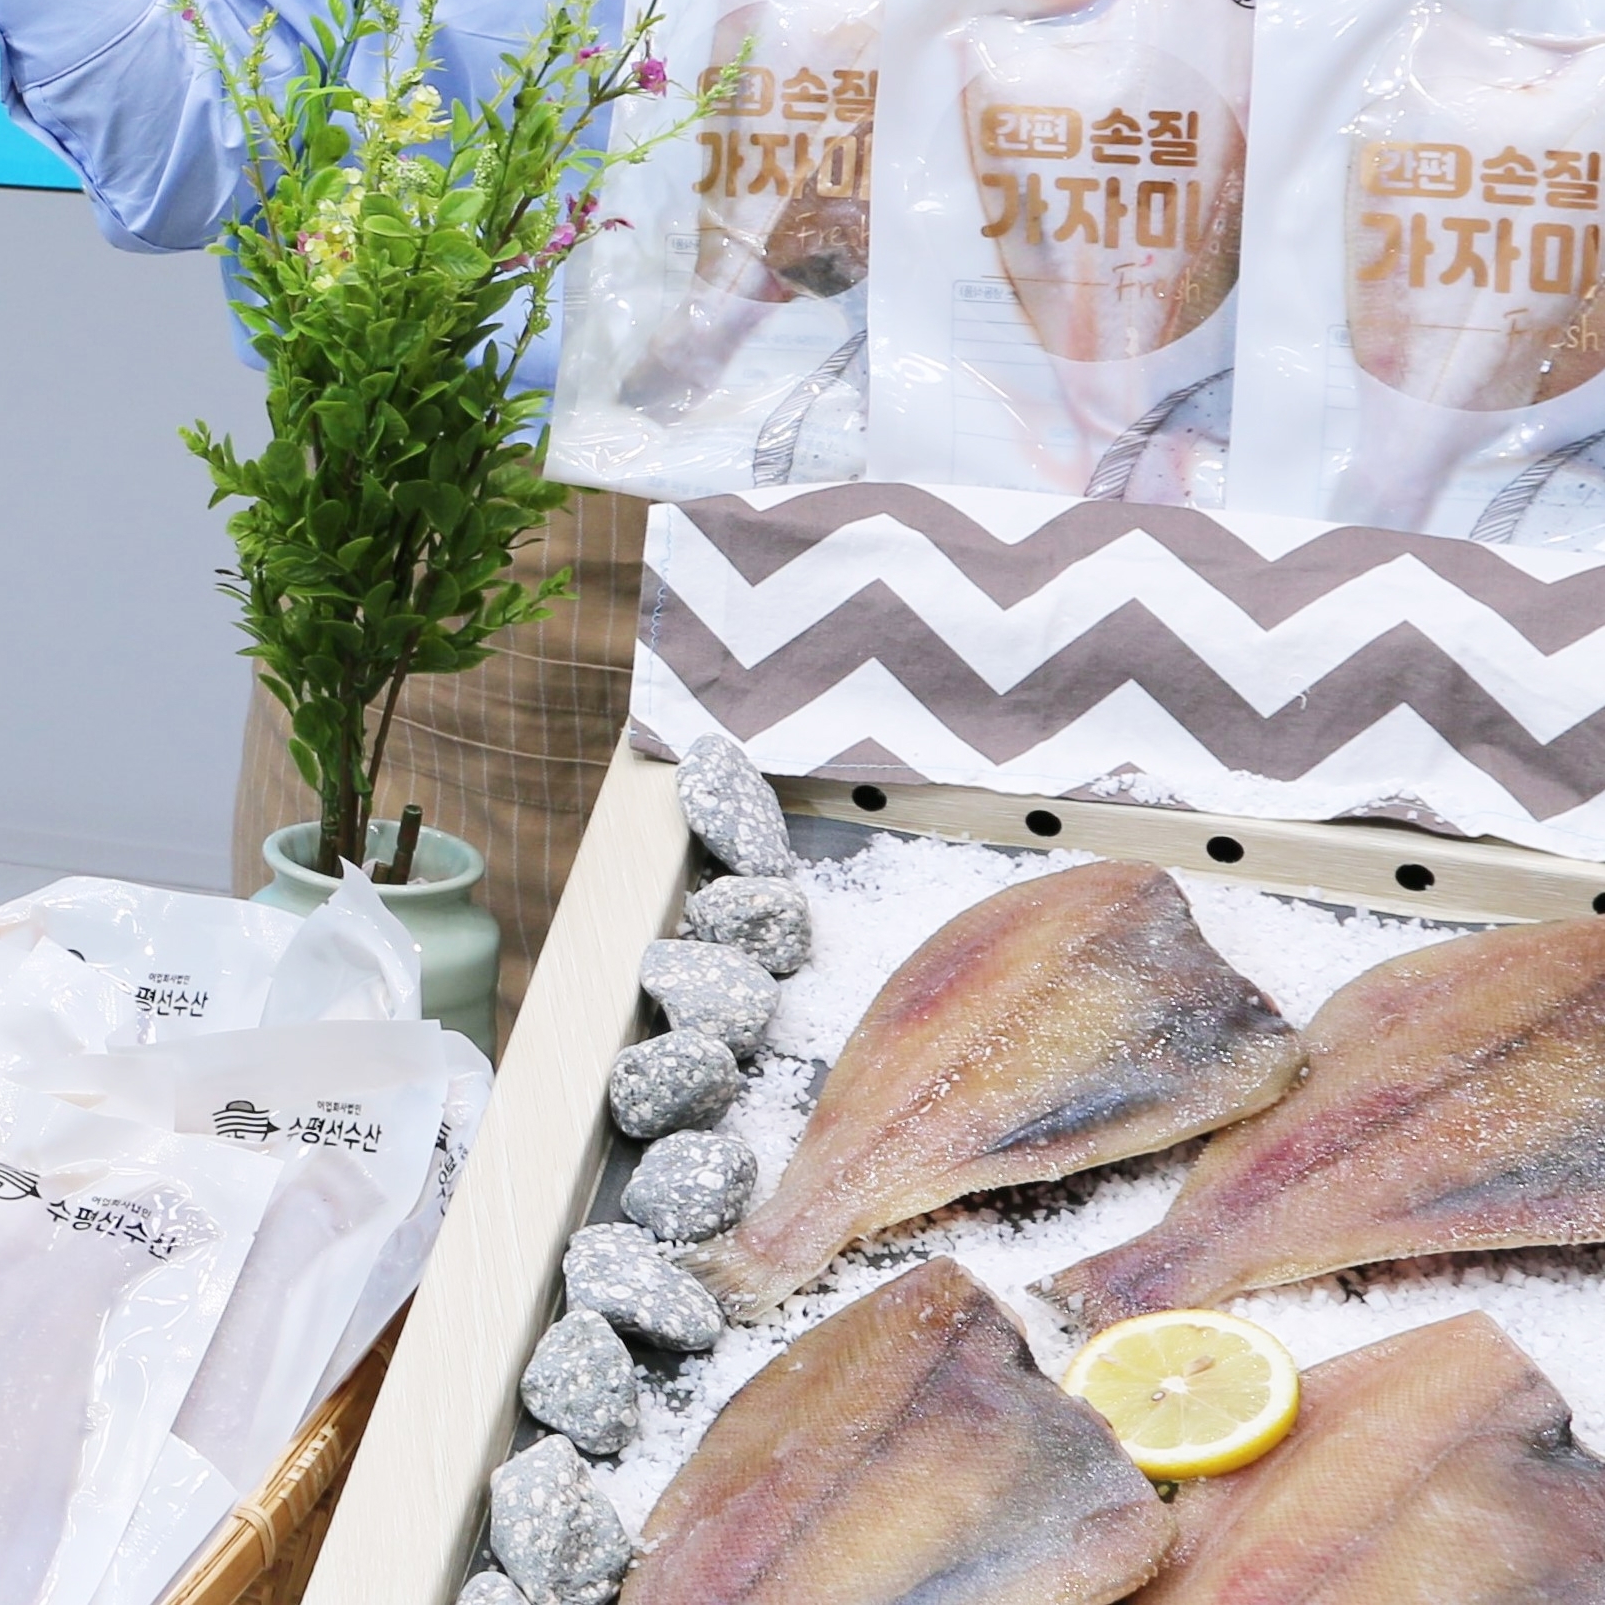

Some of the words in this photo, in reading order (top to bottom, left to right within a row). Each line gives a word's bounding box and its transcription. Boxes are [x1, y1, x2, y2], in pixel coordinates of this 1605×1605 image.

[780, 66, 879, 122] 손질
[692, 129, 872, 201] 가자미
[1090, 107, 1199, 167] 손질
[1480, 145, 1600, 211] 손질
[981, 173, 1202, 253] 가자미
[1357, 212, 1600, 302] 가자미
